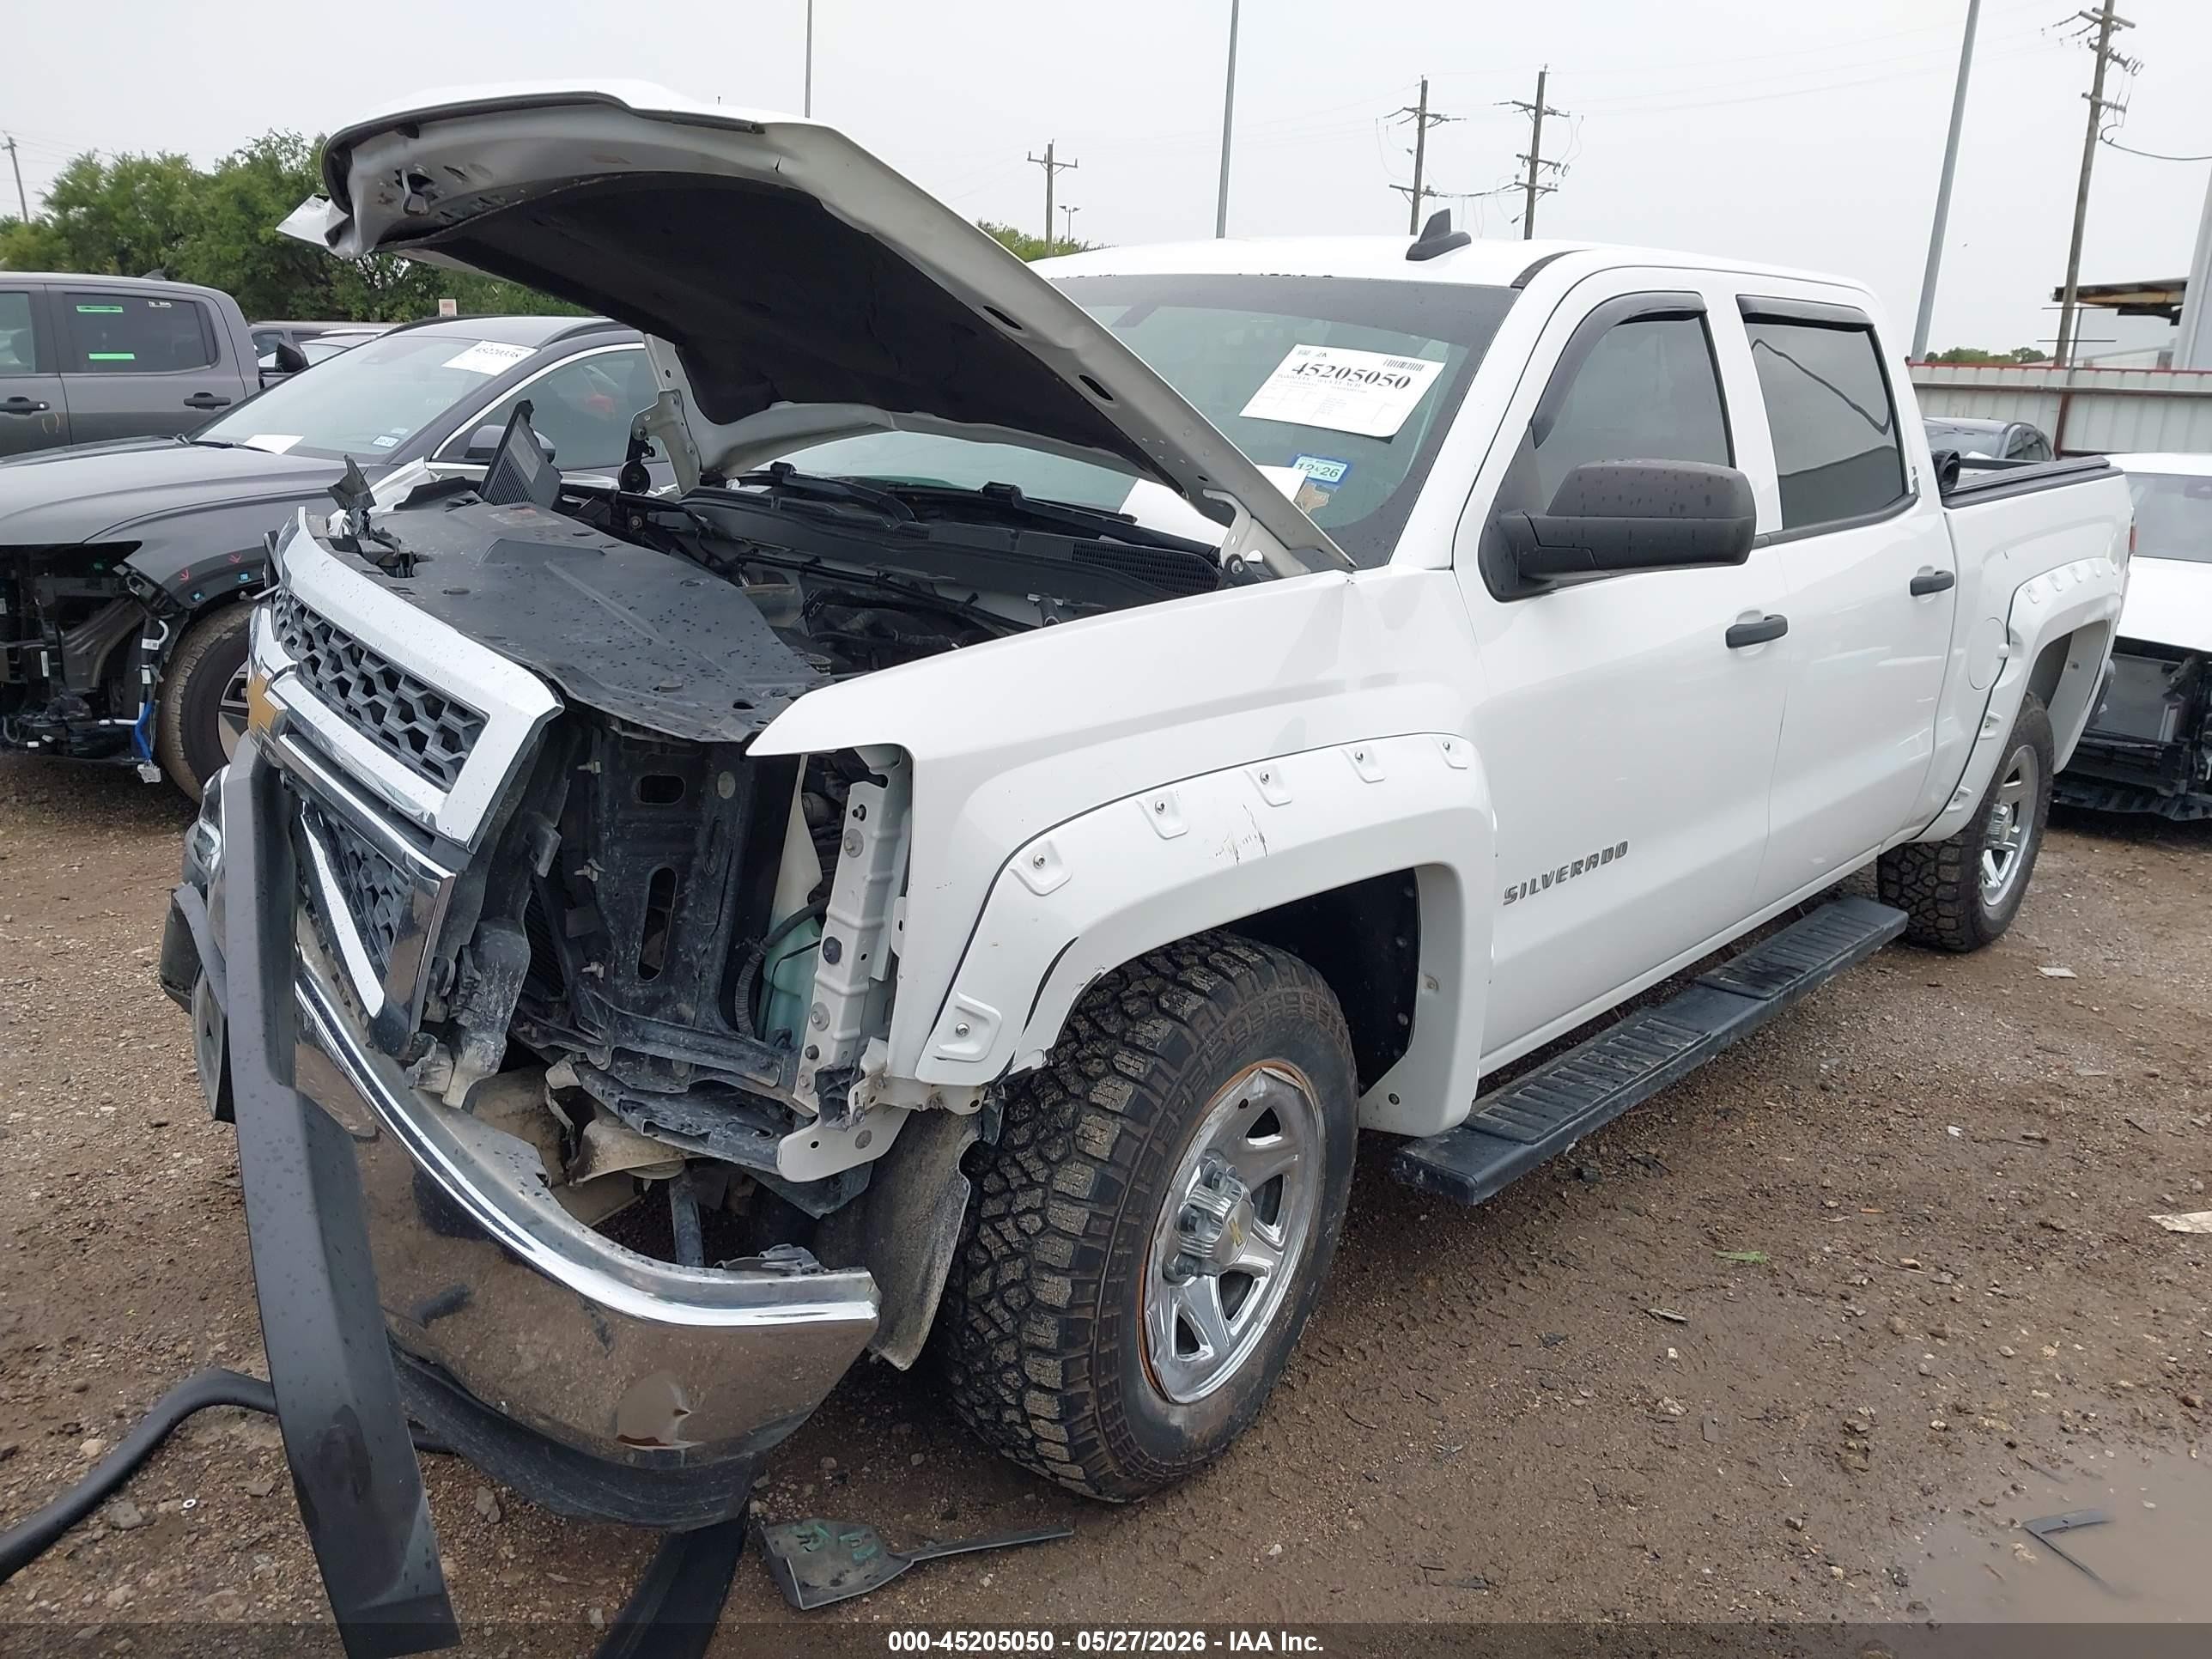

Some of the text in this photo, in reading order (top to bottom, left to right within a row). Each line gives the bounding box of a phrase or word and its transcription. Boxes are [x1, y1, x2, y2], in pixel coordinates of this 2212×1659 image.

[1291, 362, 1412, 390] 45205050
[1320, 466, 1340, 478] 26
[1503, 840, 1629, 906] SILVERADO
